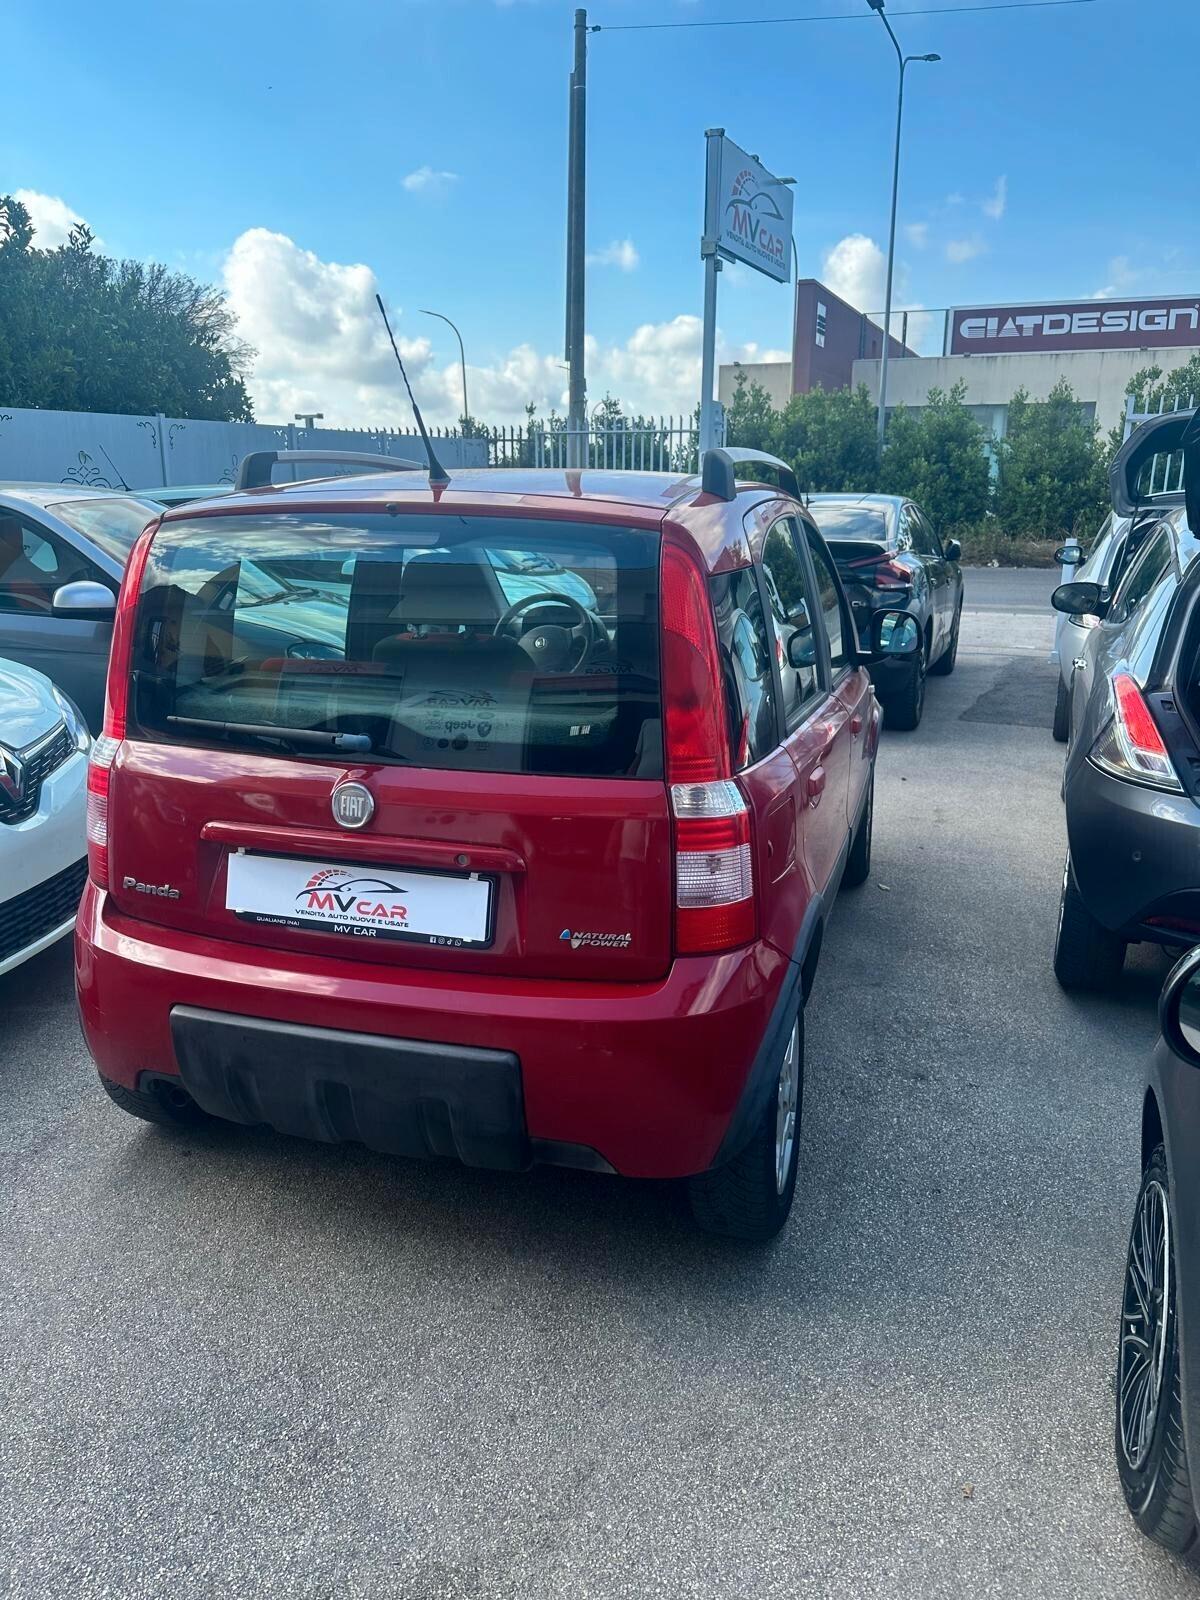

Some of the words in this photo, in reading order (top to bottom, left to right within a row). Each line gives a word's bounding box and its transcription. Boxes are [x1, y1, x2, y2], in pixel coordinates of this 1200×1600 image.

[340, 795, 364, 818] FIAT
[123, 876, 180, 899] Panda
[256, 916, 287, 925] QUALIANO
[295, 909, 326, 918] VENDITA
[327, 913, 349, 921] AUTO
[350, 915, 376, 924] NUOVE
[385, 920, 409, 928] USATE
[334, 924, 351, 934] MV
[353, 926, 377, 937] CAR
[572, 932, 632, 941] NATURAL
[581, 939, 629, 948] POWER
